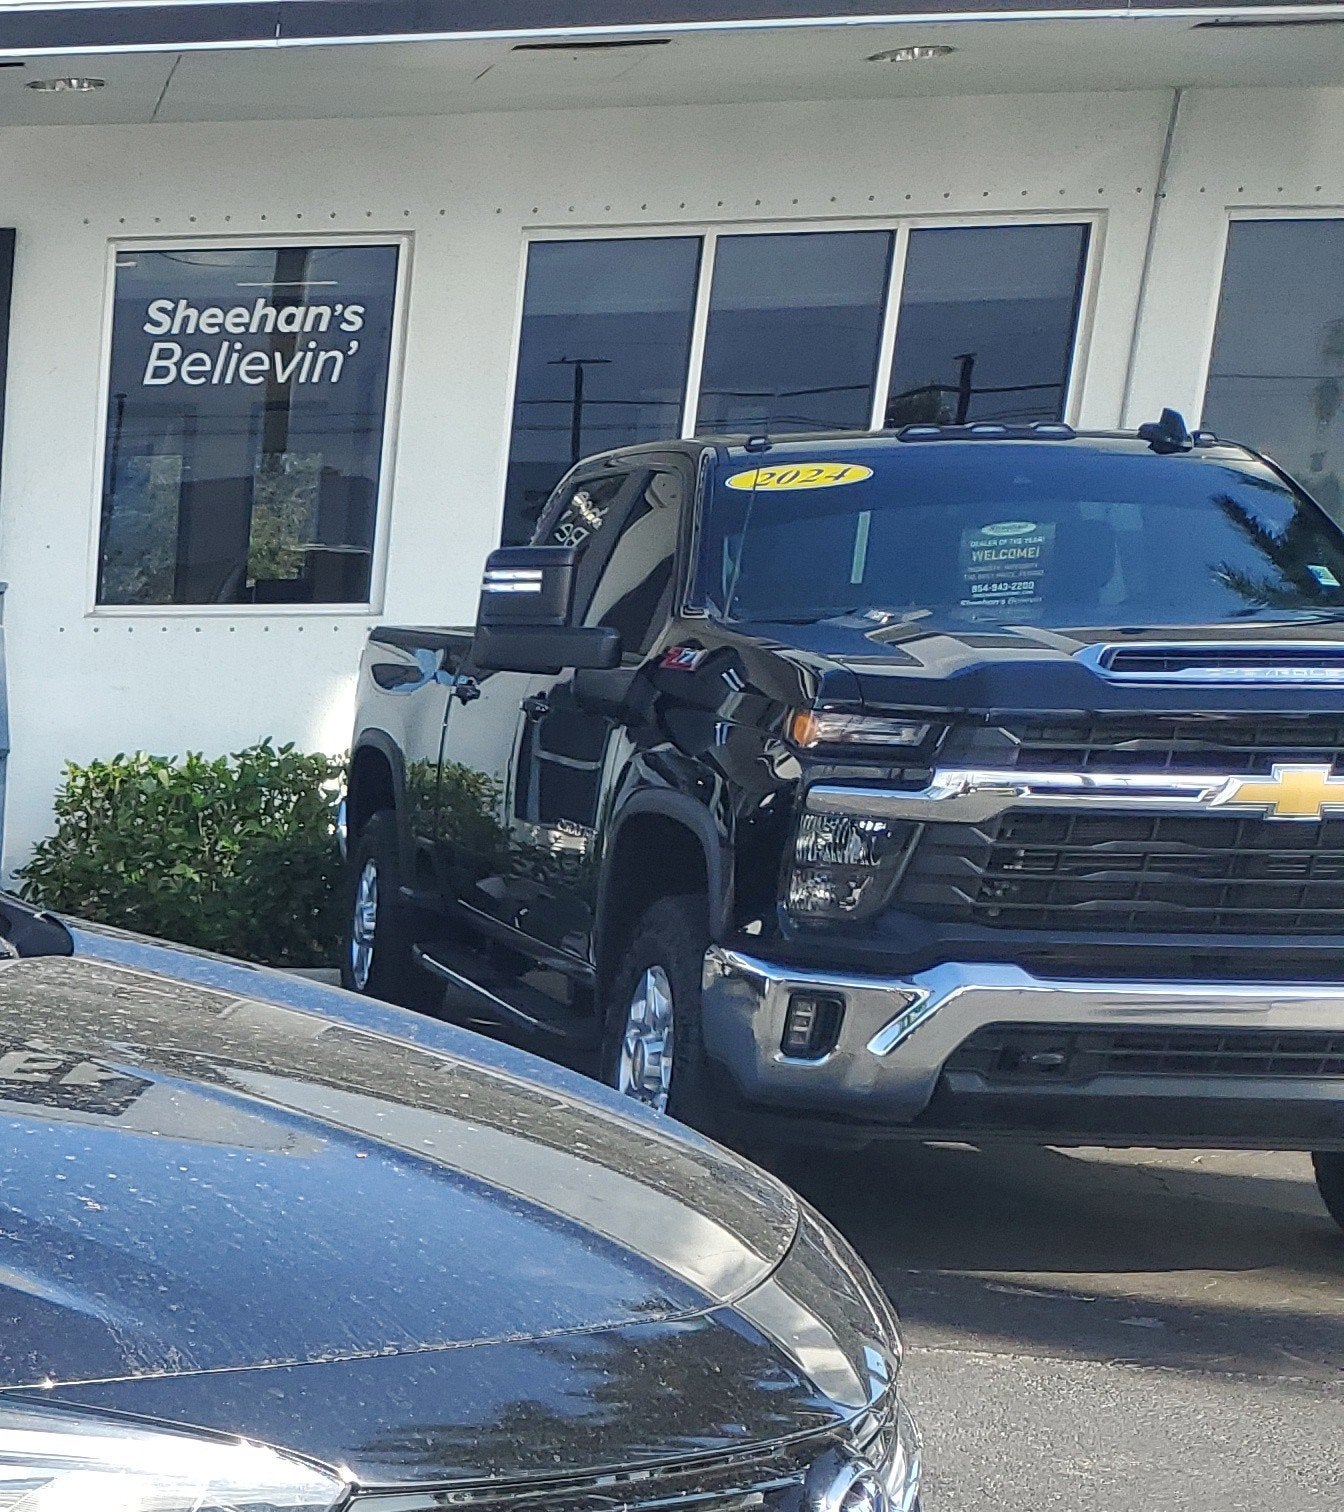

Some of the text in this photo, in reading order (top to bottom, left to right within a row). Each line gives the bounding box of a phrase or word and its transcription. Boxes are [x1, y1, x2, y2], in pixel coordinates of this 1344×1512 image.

[143, 298, 365, 335] Sheehan's
[143, 340, 360, 386] Believin'
[755, 467, 852, 487] 2024
[972, 547, 1040, 562] WELCOME!
